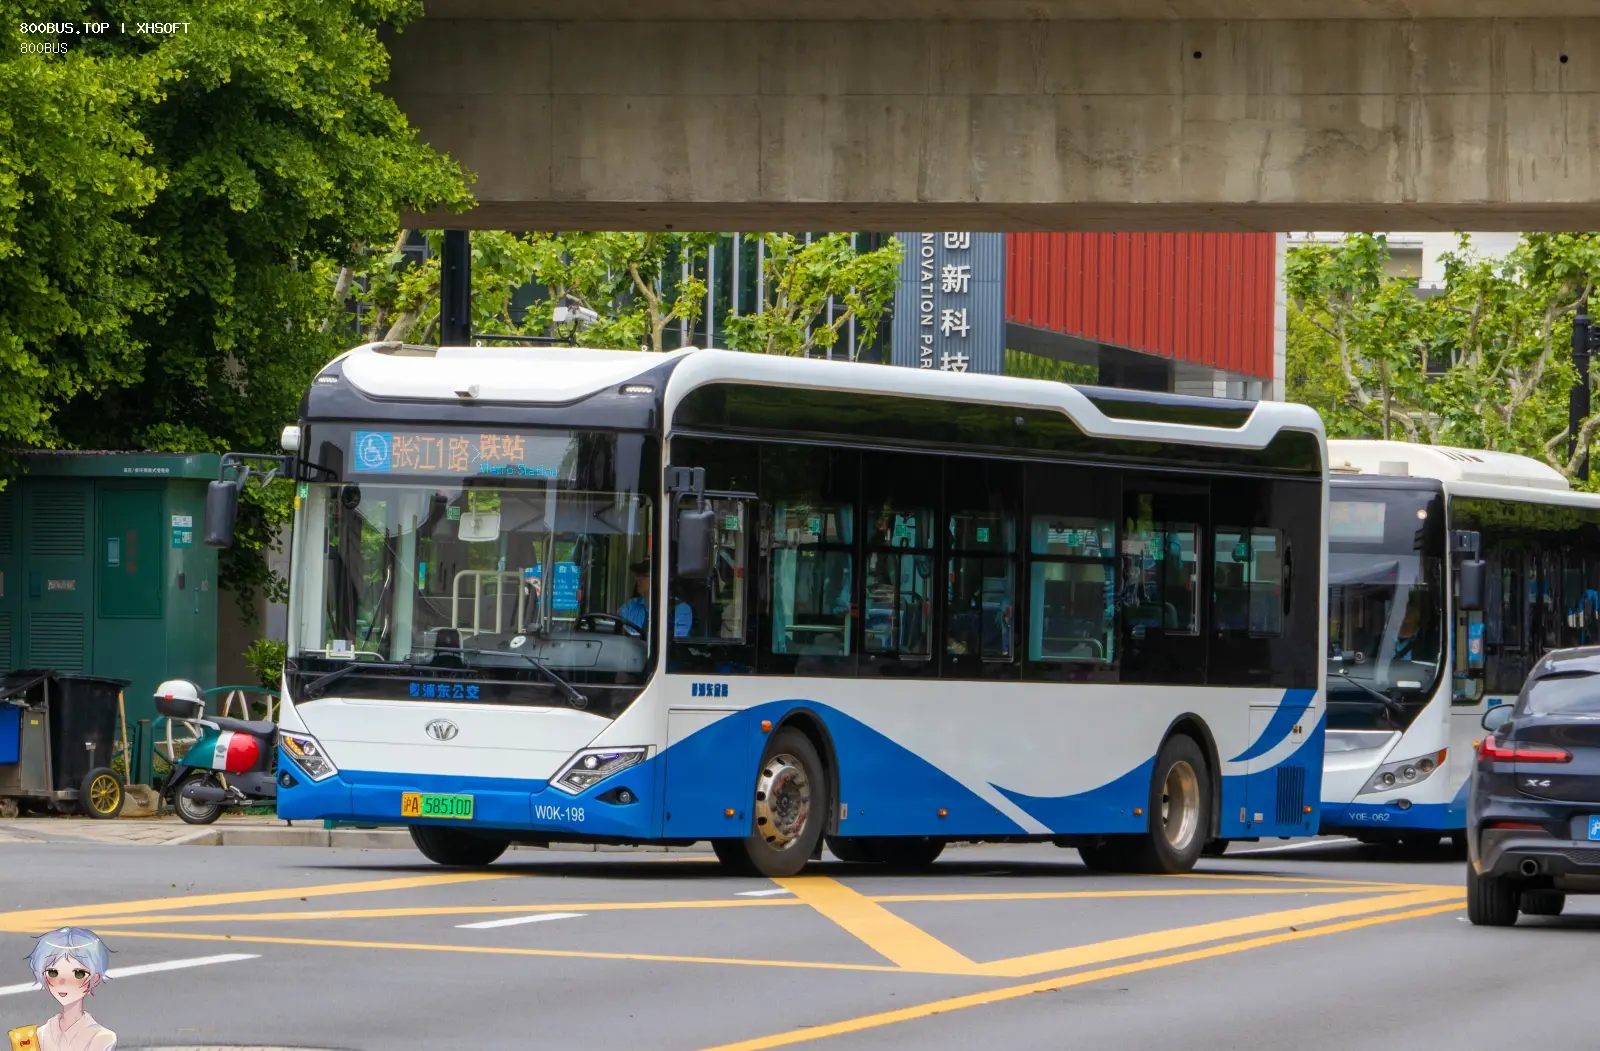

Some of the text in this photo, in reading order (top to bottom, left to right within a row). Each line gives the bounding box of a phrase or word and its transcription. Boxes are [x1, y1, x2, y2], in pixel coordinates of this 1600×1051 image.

[940, 231, 972, 373] 创新科技
[391, 435, 470, 472] 张江1路
[480, 463, 560, 478] Metro Station
[422, 683, 480, 700] 浦东公交
